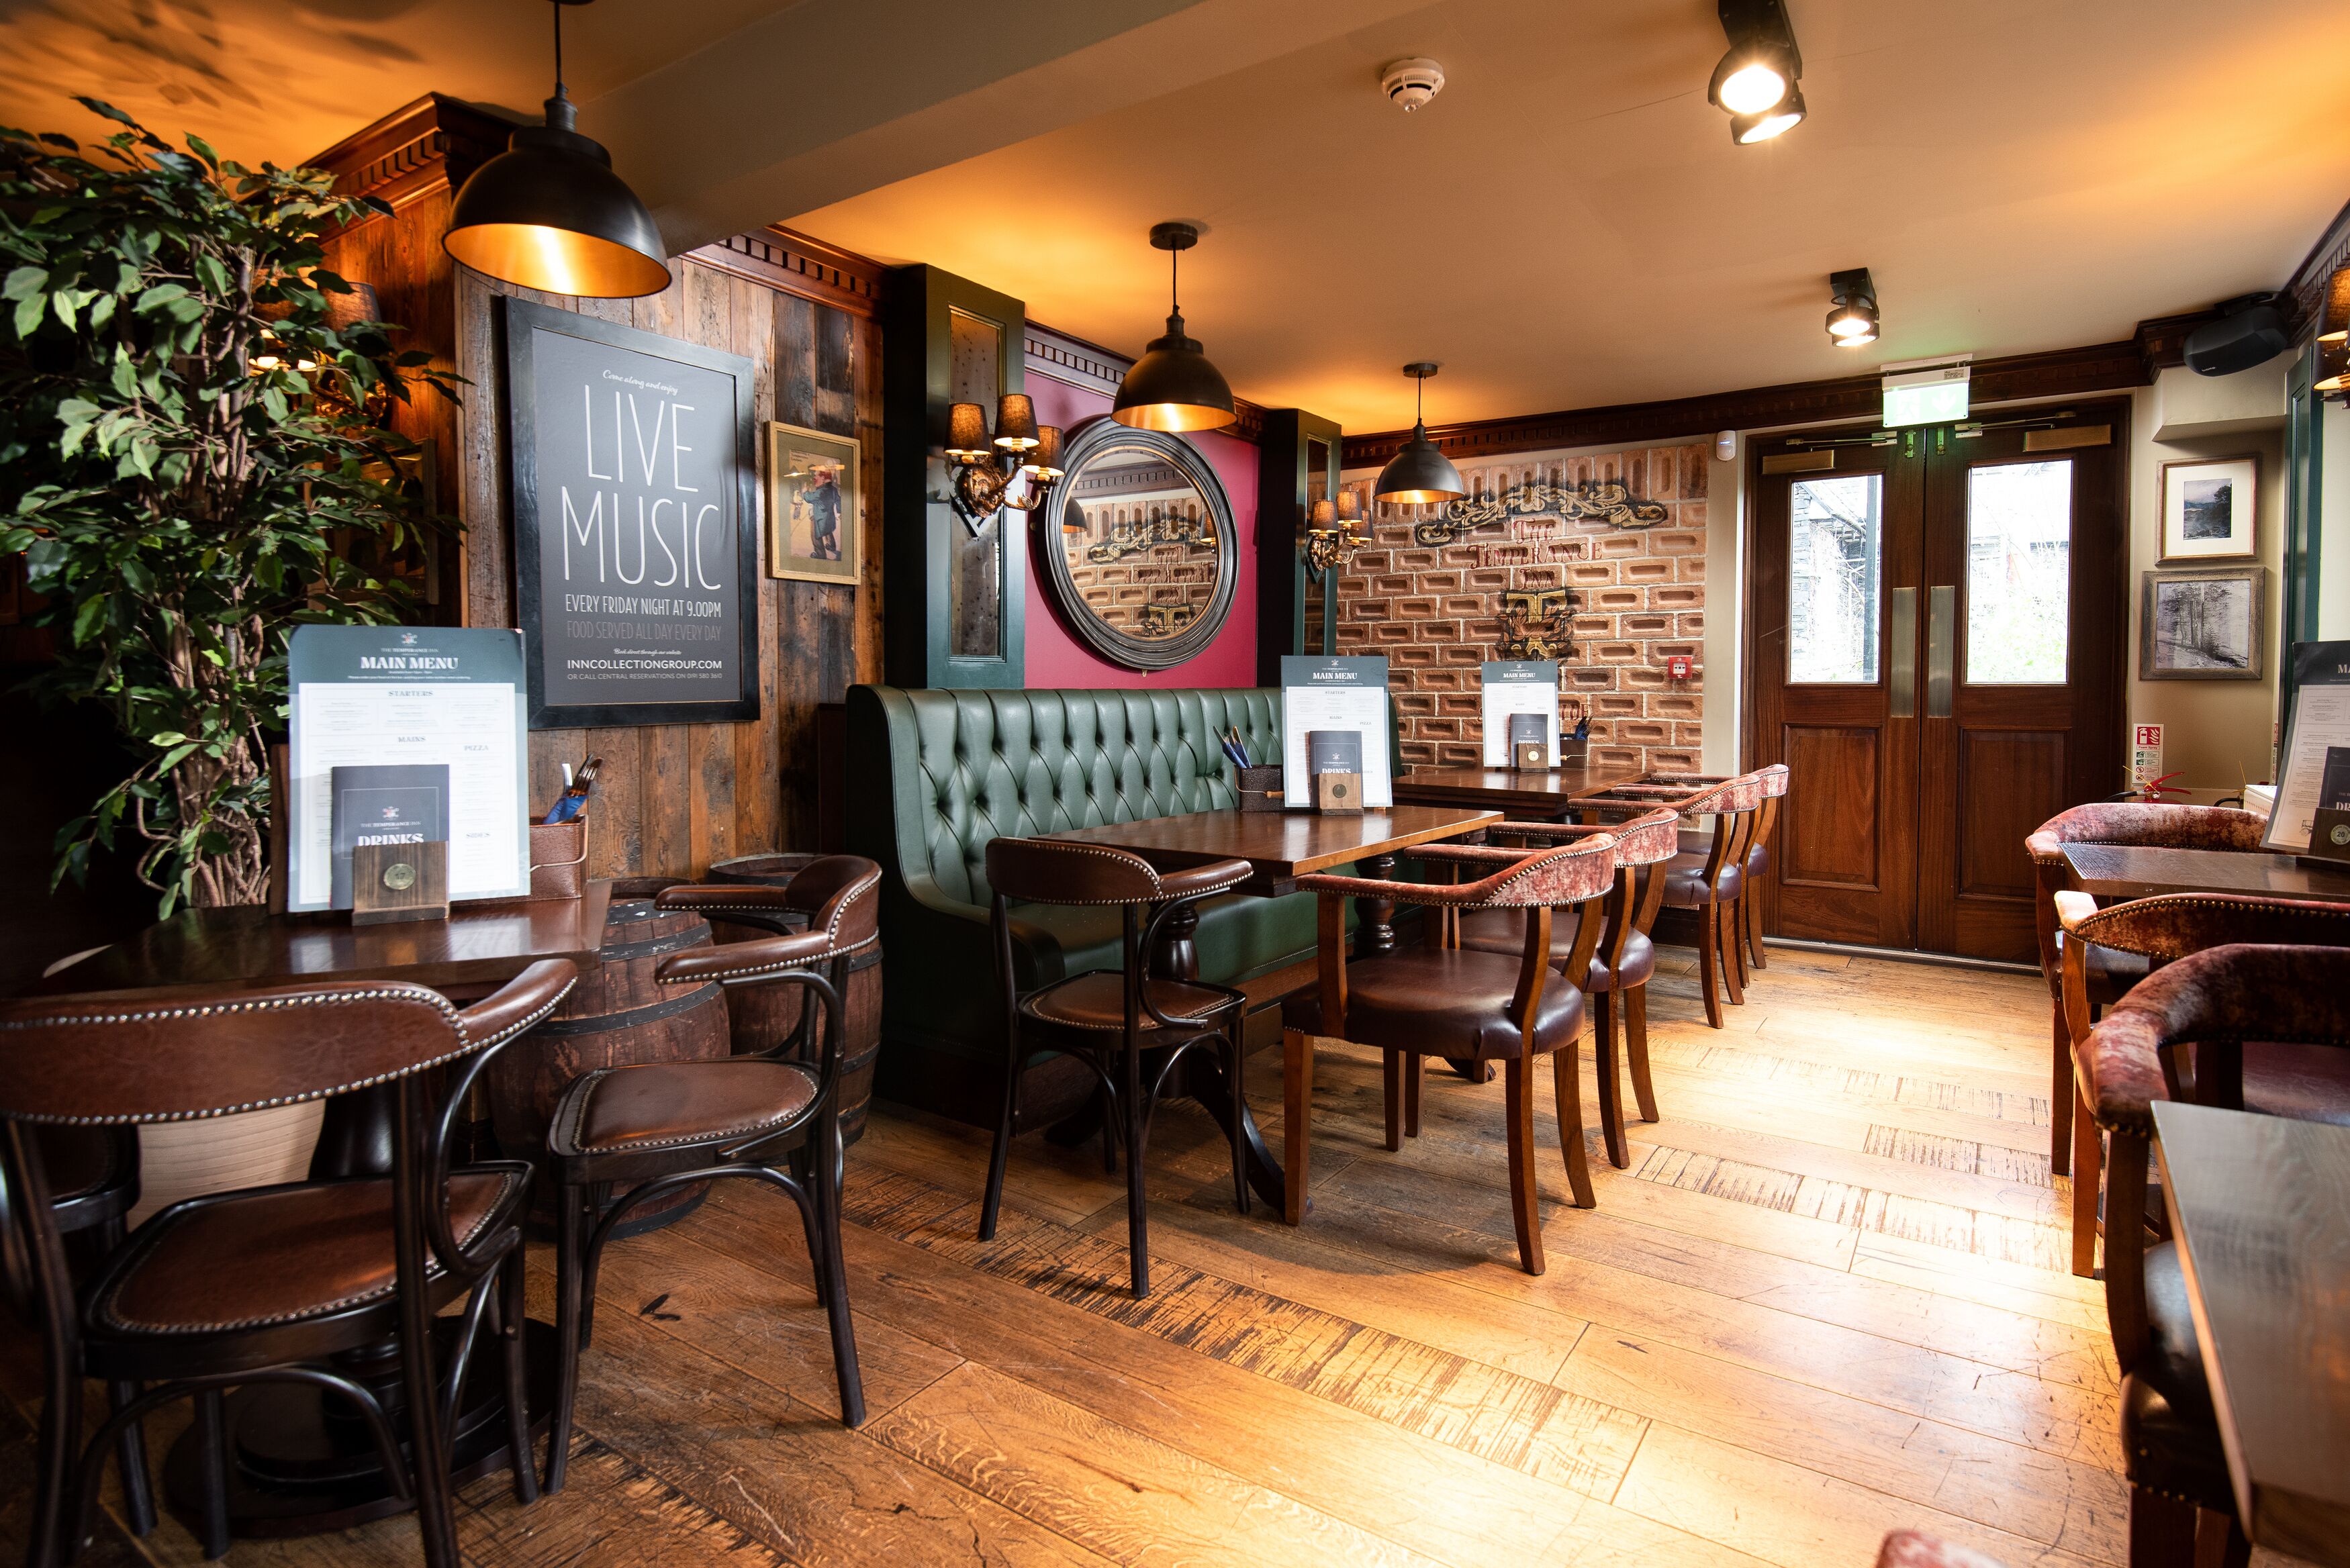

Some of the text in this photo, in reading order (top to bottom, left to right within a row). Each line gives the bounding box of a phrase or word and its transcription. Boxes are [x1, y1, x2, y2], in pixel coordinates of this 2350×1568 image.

[602, 369, 678, 396] Come along and enjoy
[585, 384, 699, 493] LIVE
[561, 485, 722, 591] MUSIC
[1513, 518, 1556, 544] THE
[1466, 542, 1603, 570] TEMPERANCE
[1519, 569, 1556, 589] INN
[565, 593, 722, 618] EVERY FRIDAY NIGHT AT 9.00PM
[567, 620, 722, 641] FOOD SERVED ALL DAY EVERY DAY
[361, 656, 459, 670] MAIN MENU
[567, 659, 722, 669] INNCOLLECTIONGROUP.COM
[2338, 664, 2350, 674] M
[1313, 672, 1358, 680] MAIN MENU
[357, 832, 424, 846] DRINKS
